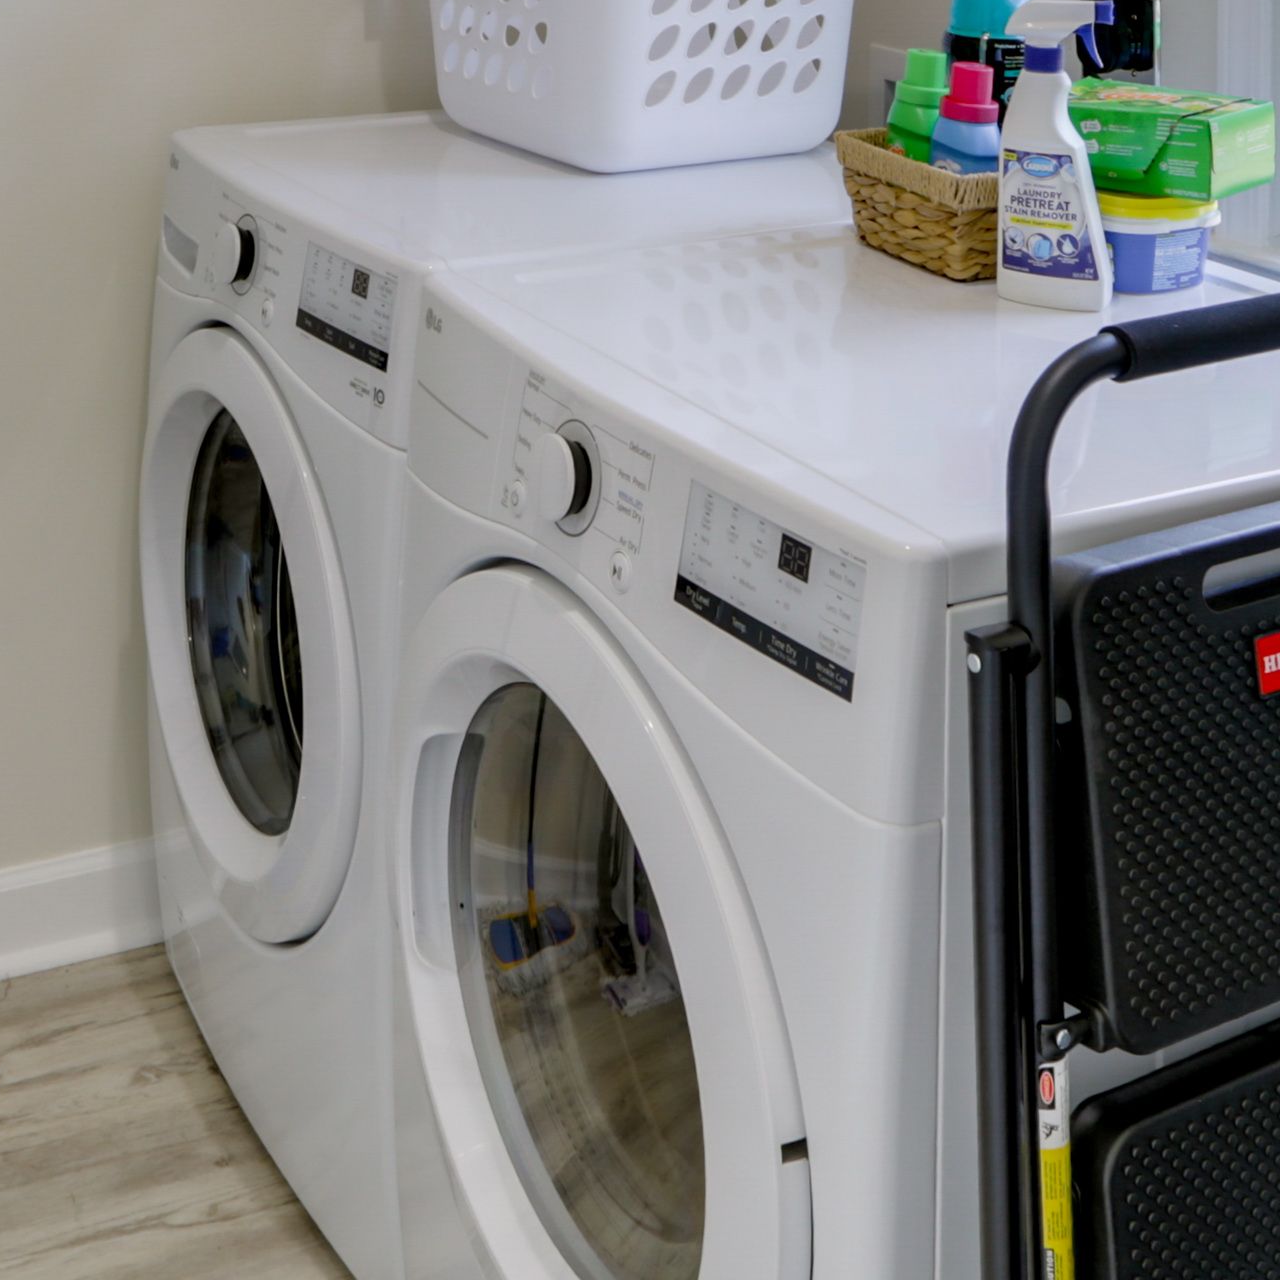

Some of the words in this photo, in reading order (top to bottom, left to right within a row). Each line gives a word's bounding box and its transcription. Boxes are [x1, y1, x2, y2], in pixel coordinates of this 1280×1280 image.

[1017, 187, 1063, 200] LAUNDRY
[1010, 194, 1072, 212] PRETREAT
[1004, 205, 1029, 216] STAIN
[1030, 209, 1078, 221] REMOVER
[771, 633, 785, 651] Time
[785, 640, 798, 658] Dry
